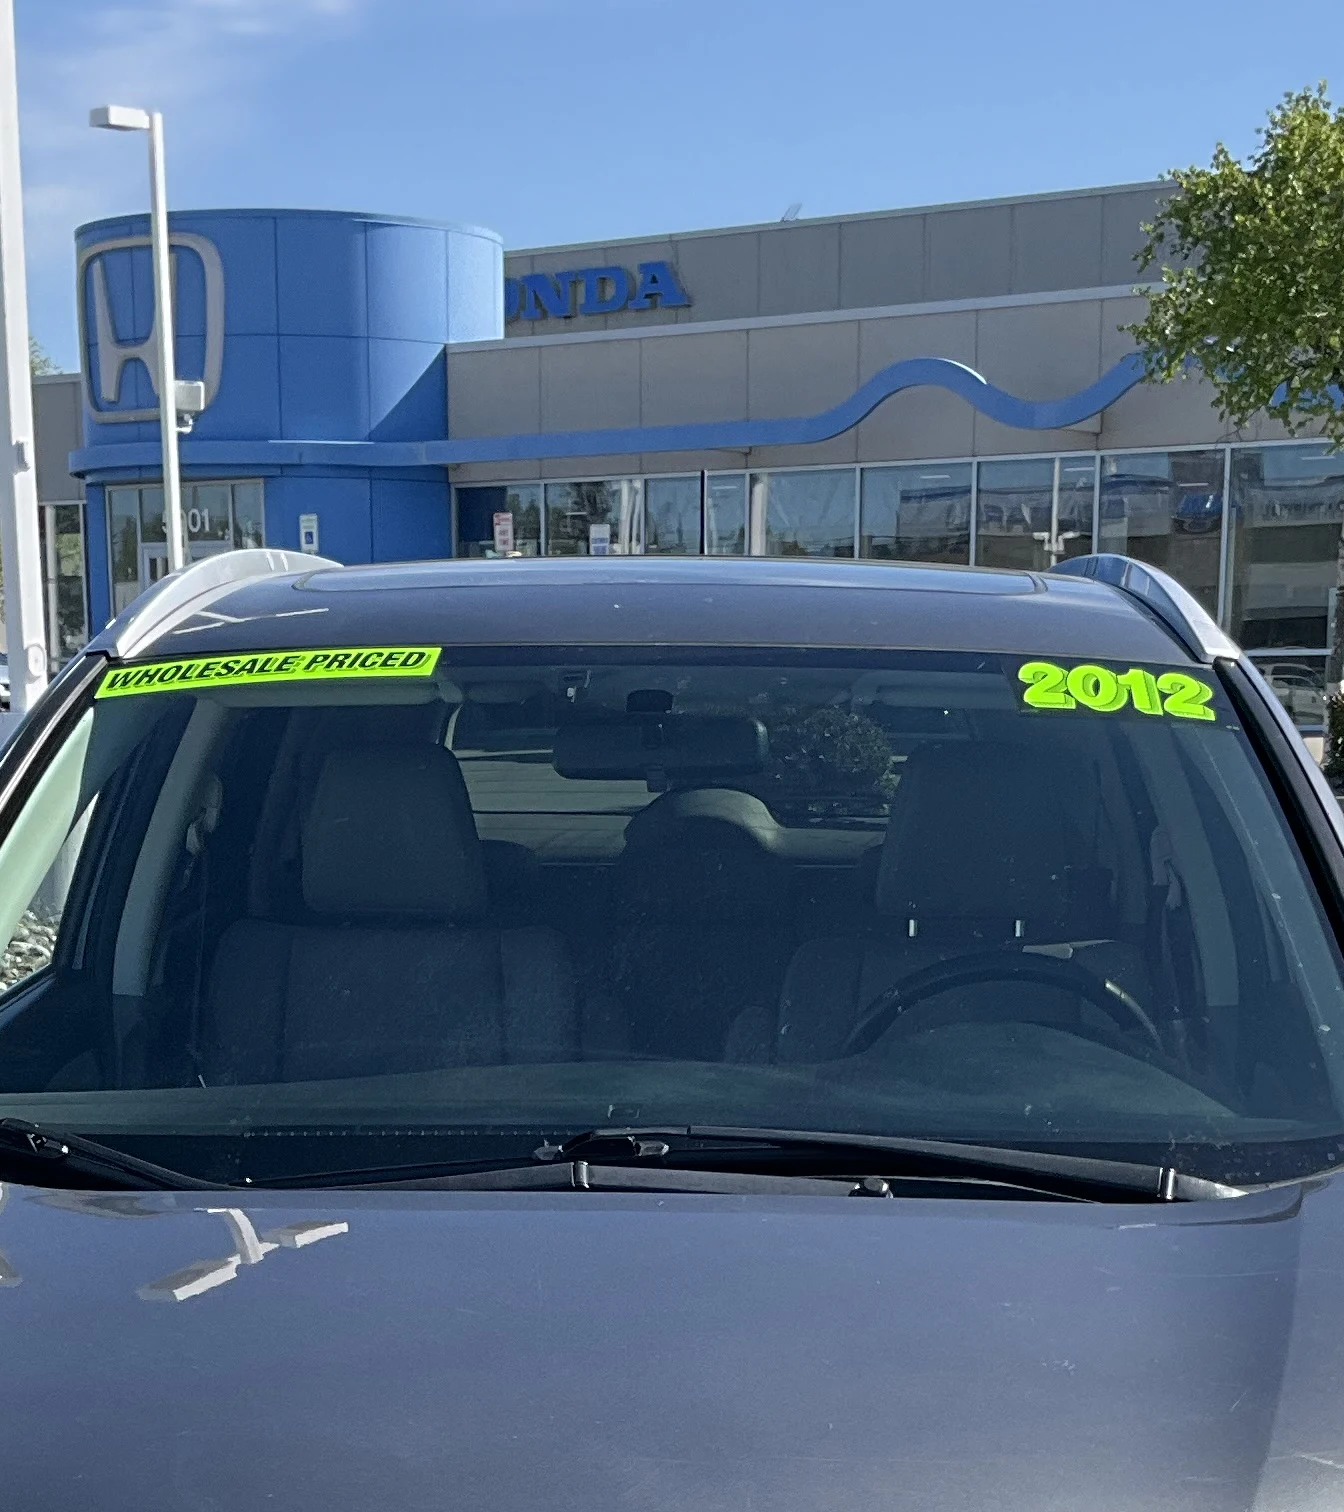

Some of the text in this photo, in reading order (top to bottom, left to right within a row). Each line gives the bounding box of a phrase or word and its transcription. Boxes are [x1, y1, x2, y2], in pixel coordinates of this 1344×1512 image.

[107, 651, 429, 689] WHOLESALE PRICED
[1018, 662, 1215, 721] 2012
